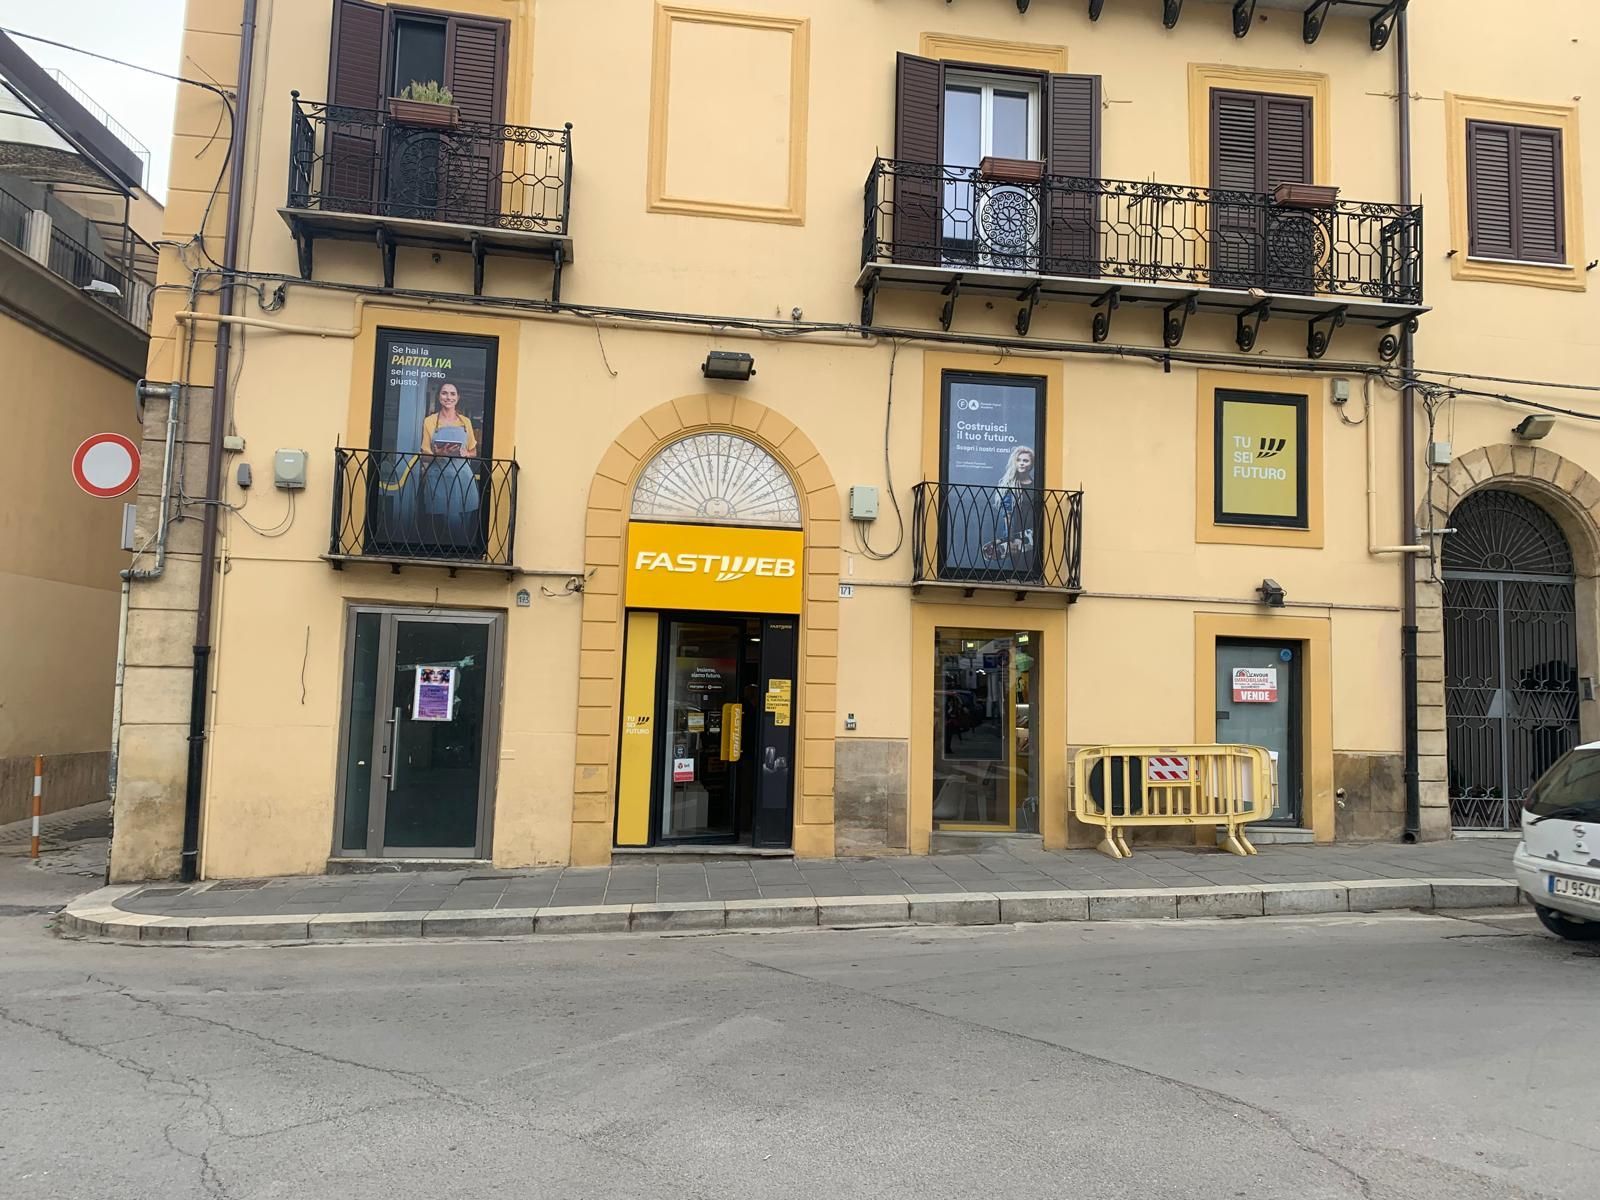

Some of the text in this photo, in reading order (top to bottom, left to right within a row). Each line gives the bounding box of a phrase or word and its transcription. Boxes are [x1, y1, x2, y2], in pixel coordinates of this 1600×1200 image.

[392, 345, 429, 356] Se hai la
[391, 355, 452, 369] PARTITA IVA
[390, 368, 446, 379] sei nel posto
[956, 420, 1008, 432] Costruisci
[956, 430, 1018, 443] il tuo futuro.
[1233, 435, 1251, 448] TU
[1233, 451, 1253, 464] SEI
[1233, 466, 1286, 480] FUTURO
[635, 551, 796, 582] FASTWEB
[1240, 690, 1270, 701] VENDE
